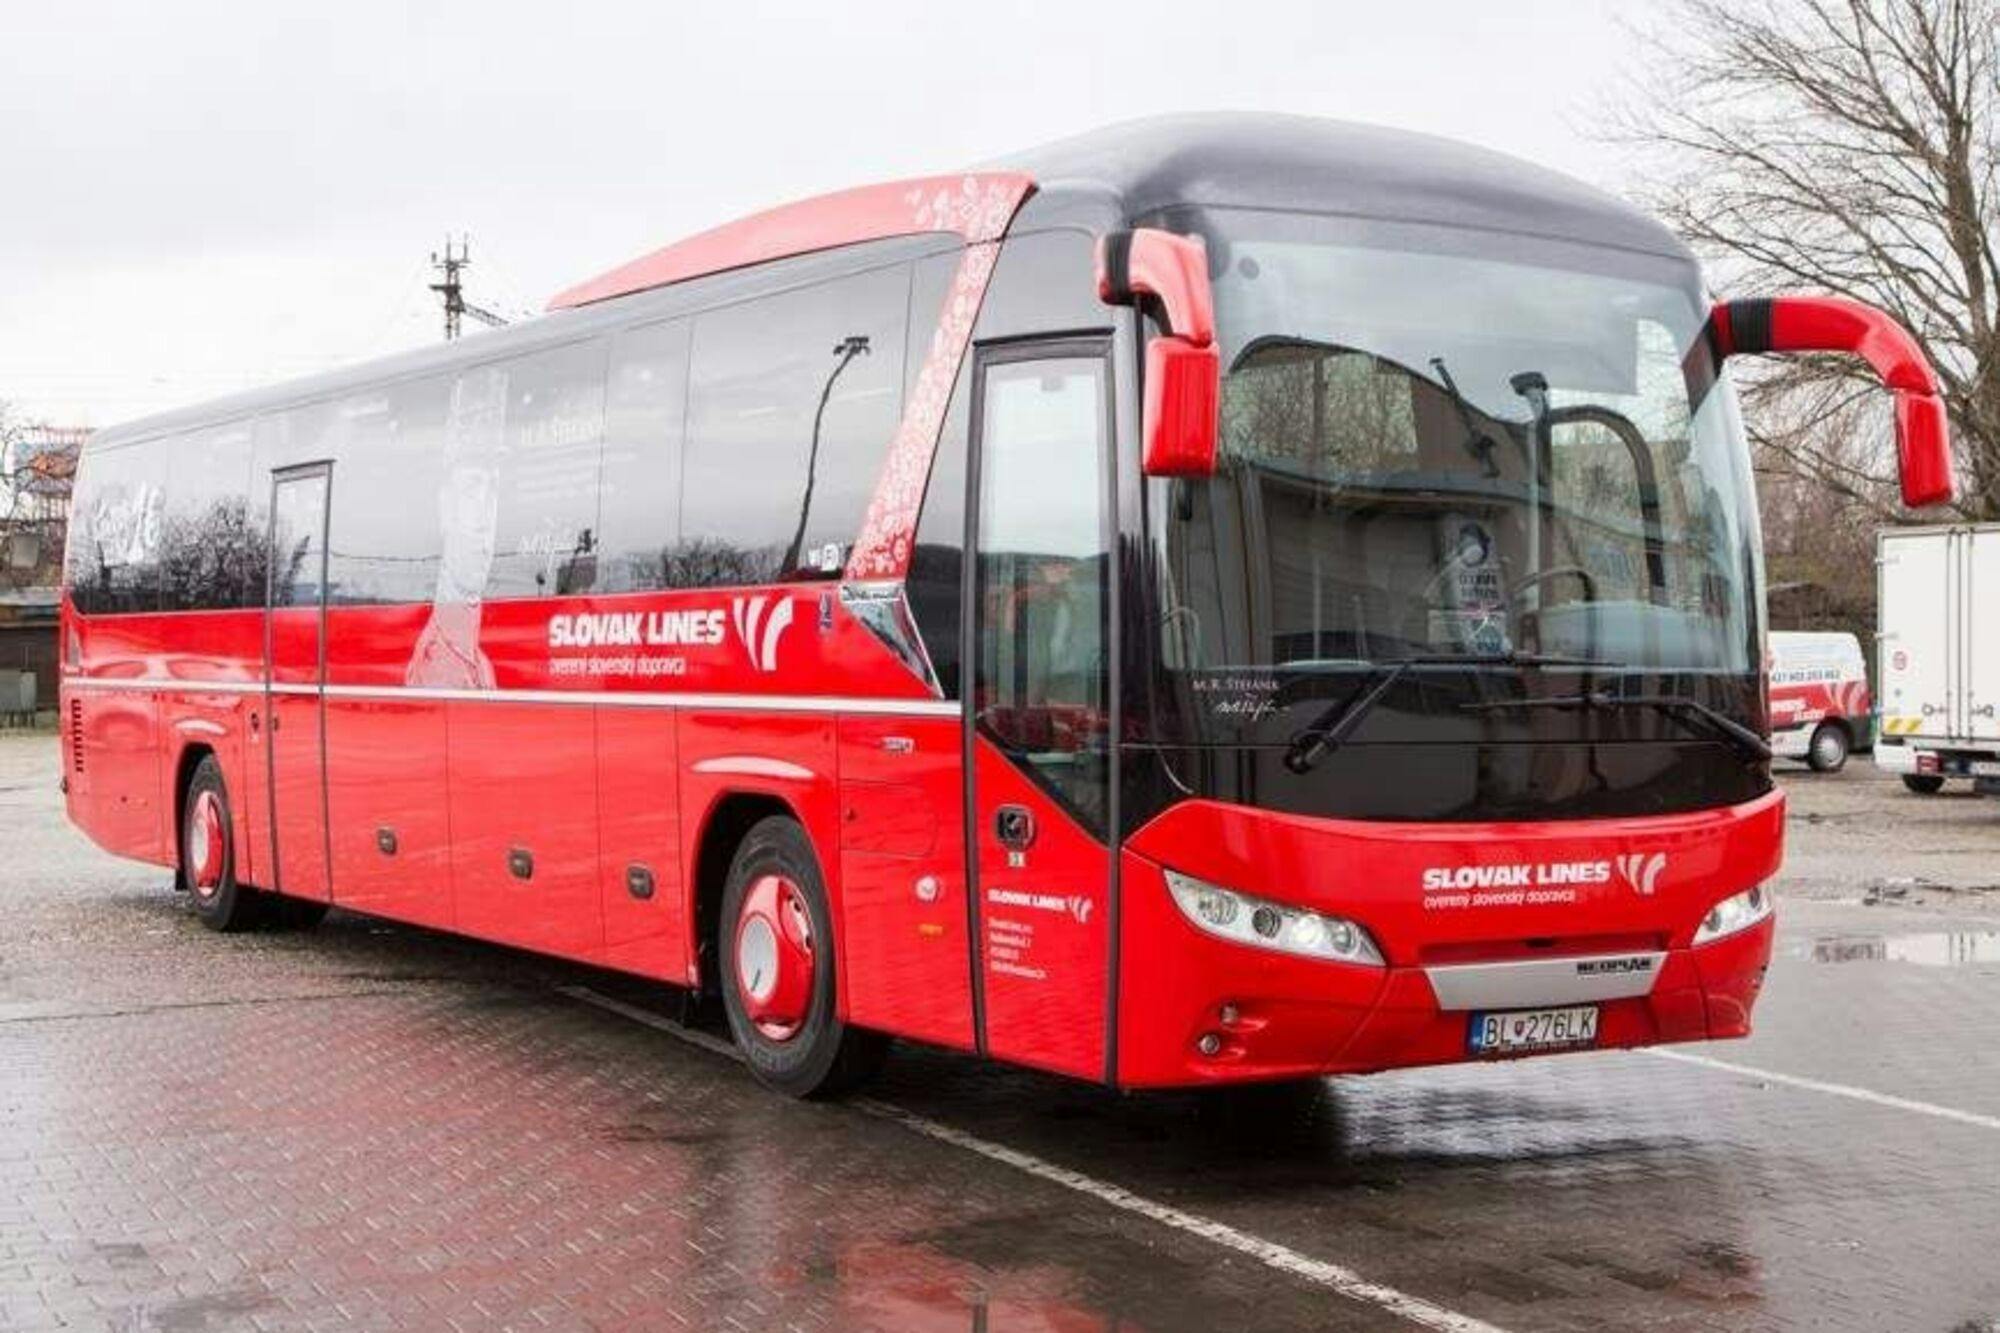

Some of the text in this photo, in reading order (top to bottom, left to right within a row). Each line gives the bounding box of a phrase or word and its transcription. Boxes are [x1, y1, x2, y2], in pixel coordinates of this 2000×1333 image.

[549, 609, 725, 647] SLOVAK LINES
[1423, 862, 1611, 889] SLOVAK LINES
[1485, 1009, 1594, 1046] BL 276LK
